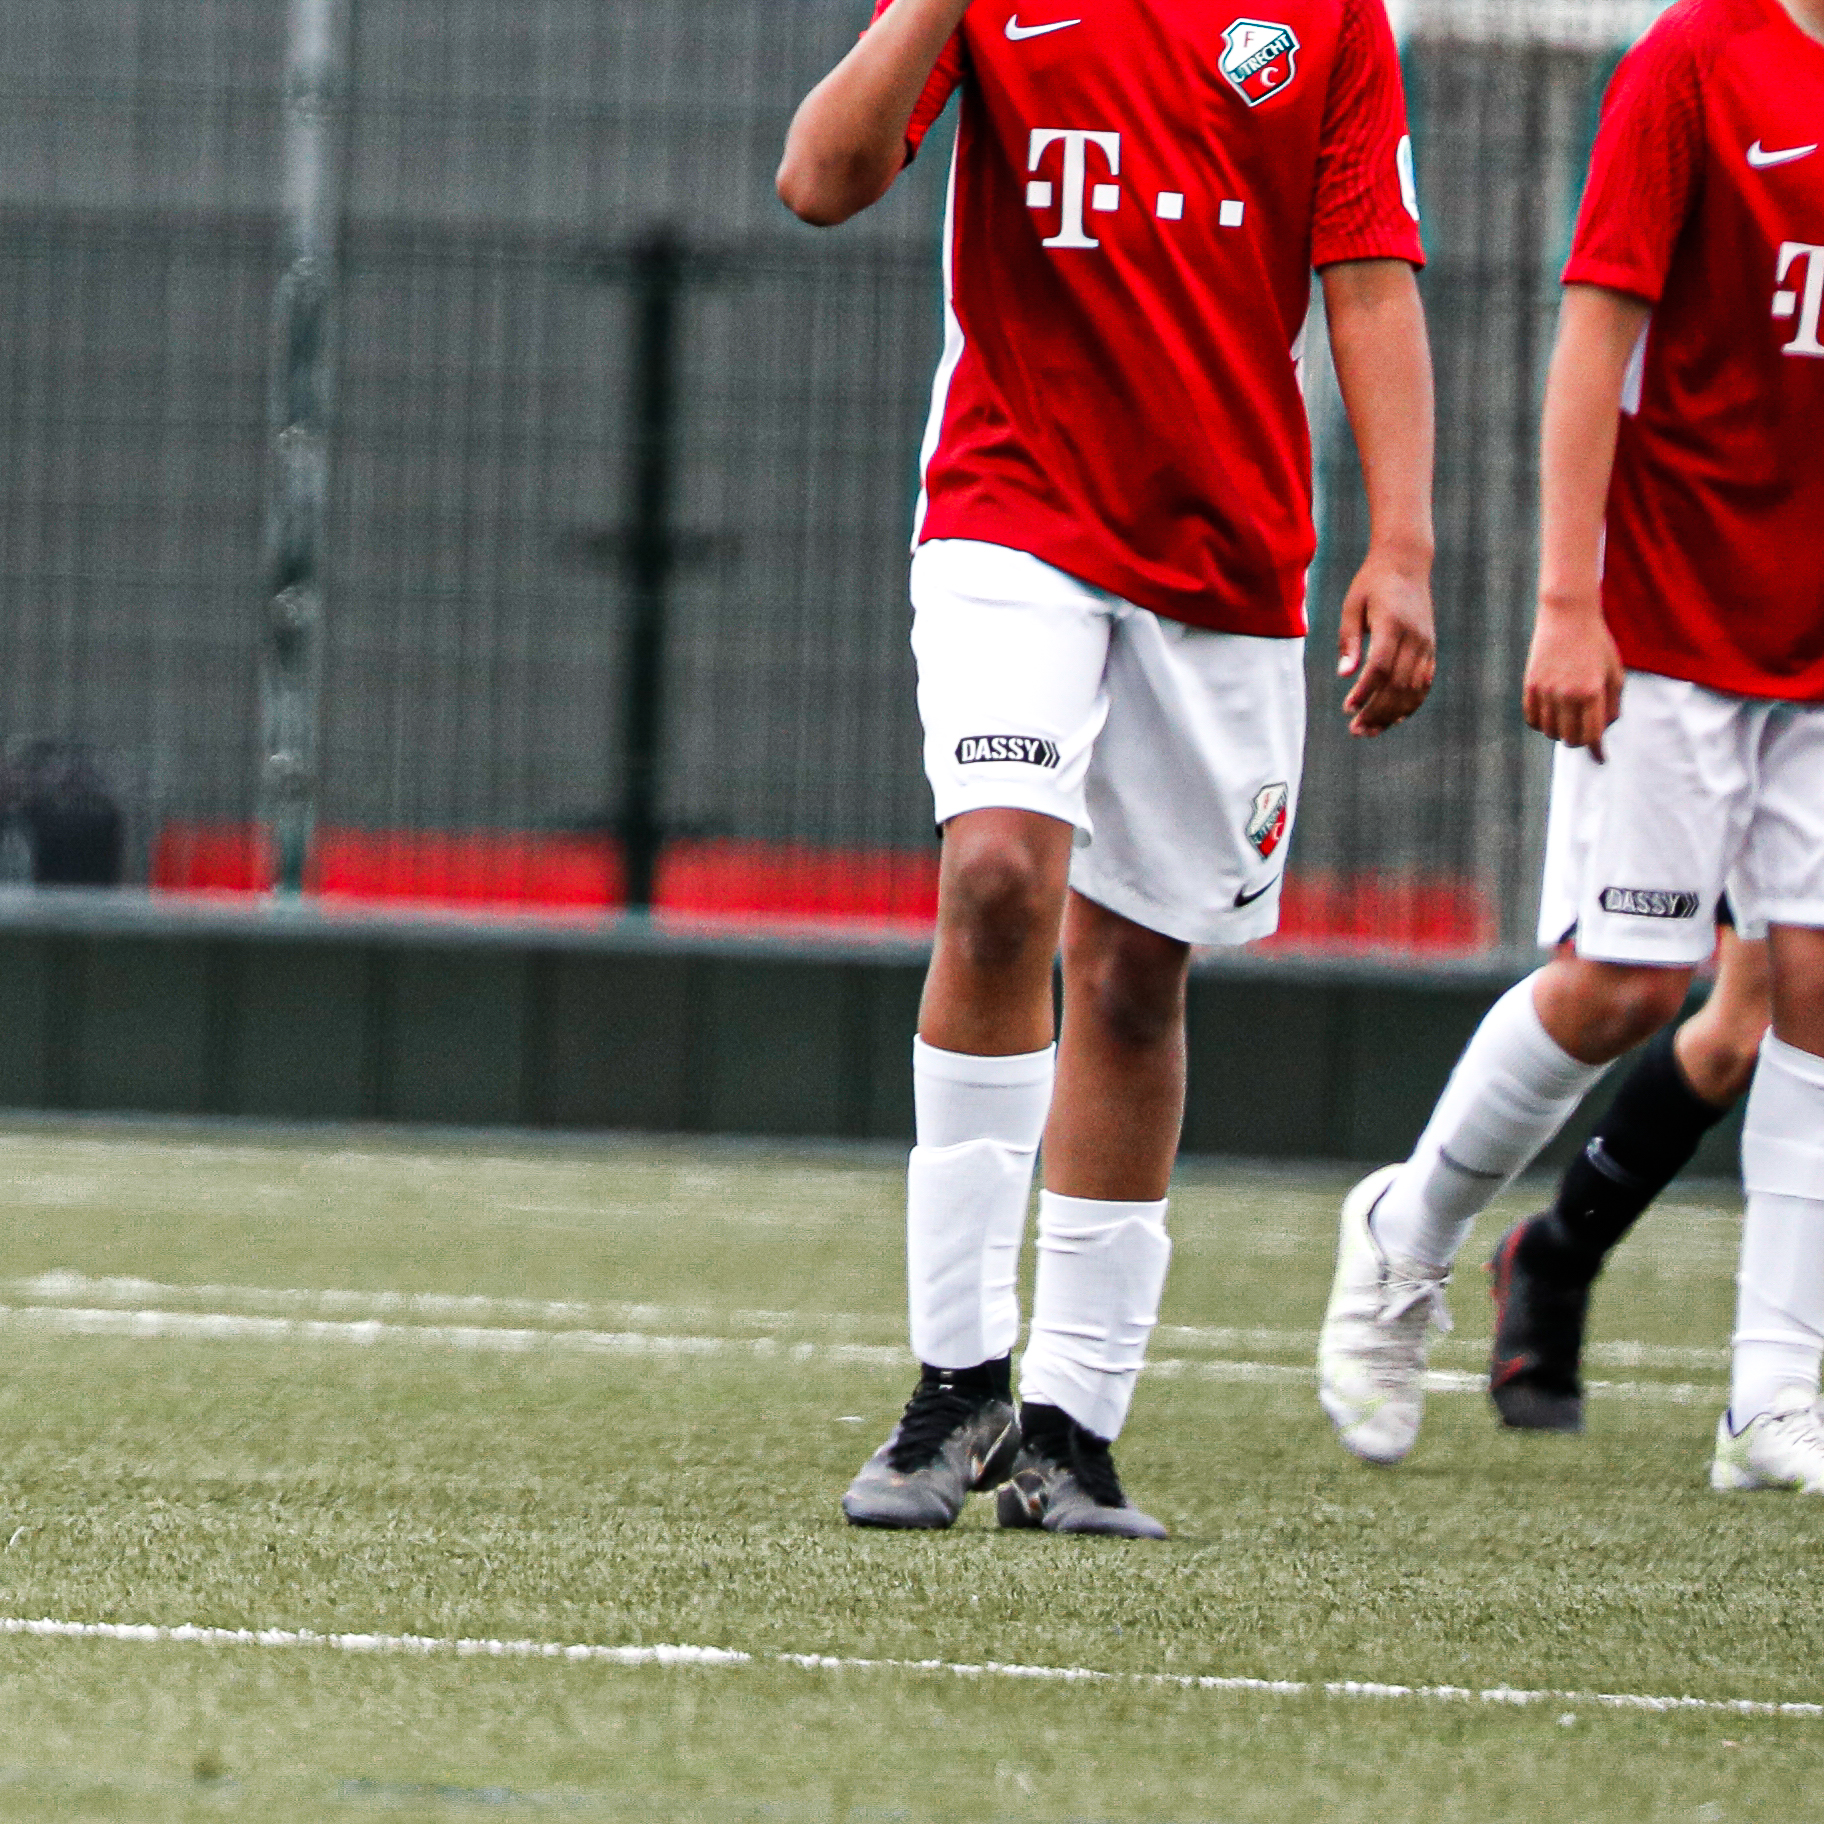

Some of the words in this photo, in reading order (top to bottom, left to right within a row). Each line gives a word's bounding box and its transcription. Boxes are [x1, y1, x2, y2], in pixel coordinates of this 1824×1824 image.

[1243, 30, 1256, 48] F
[1229, 32, 1291, 84] UTRECHT
[1260, 65, 1279, 88] C
[960, 736, 1041, 764] DASSY
[1604, 887, 1681, 917] DASSY
